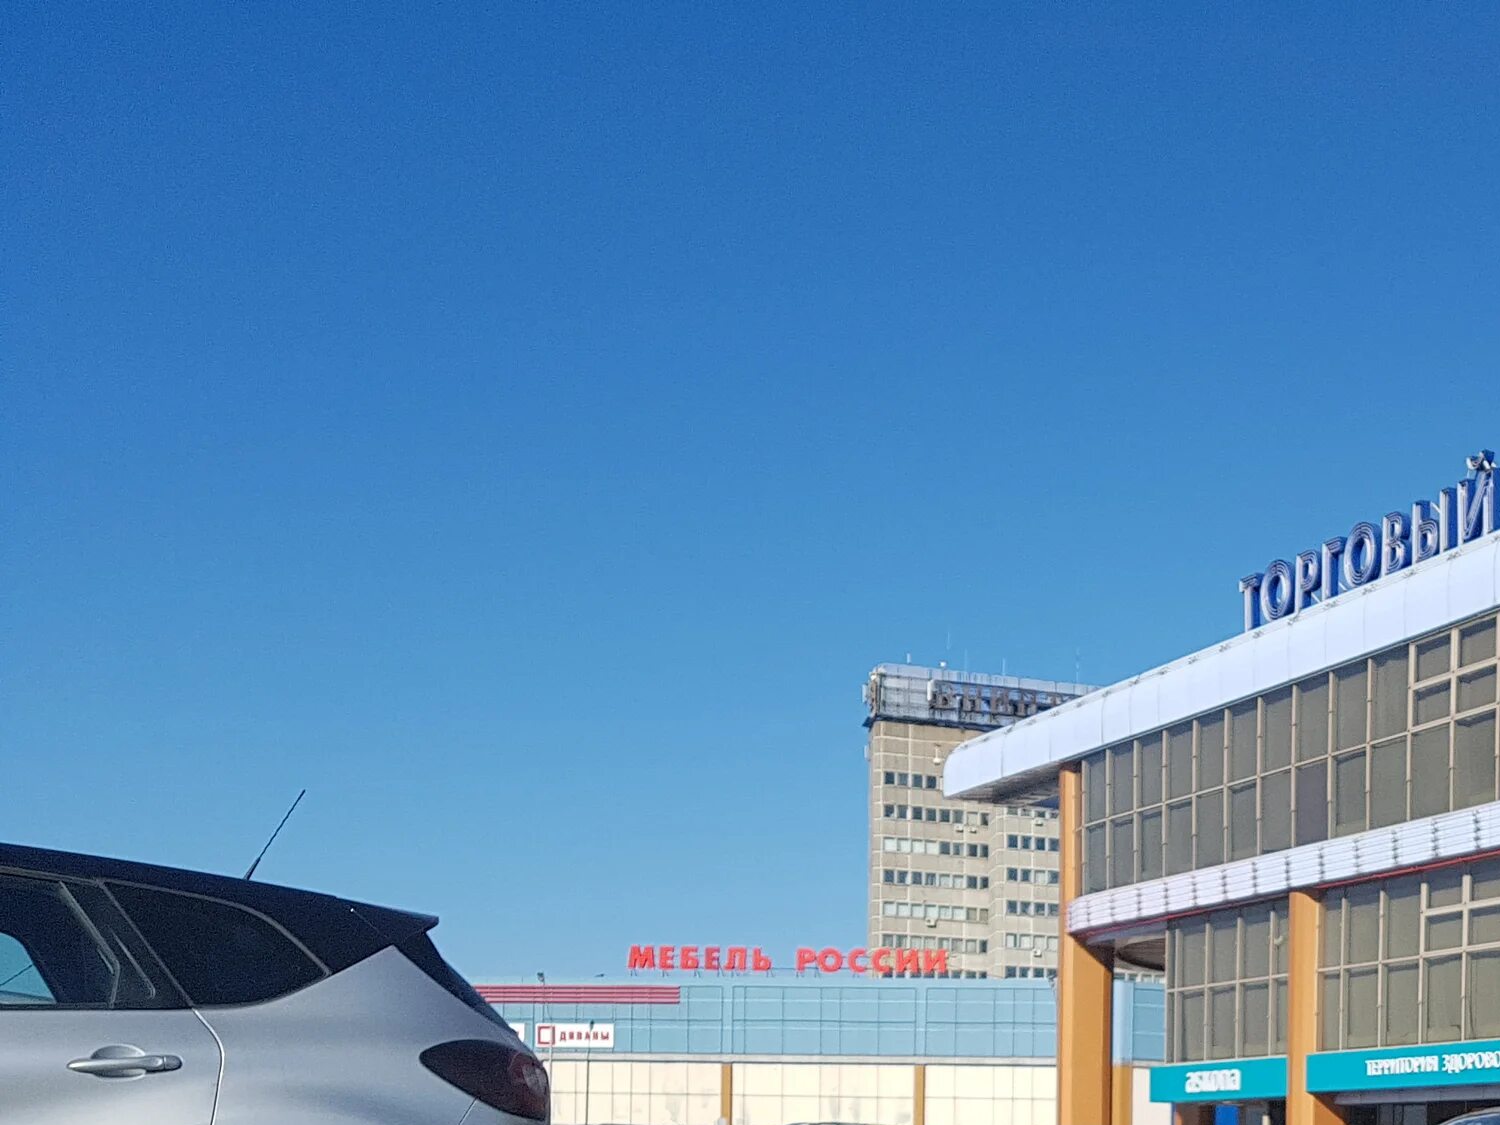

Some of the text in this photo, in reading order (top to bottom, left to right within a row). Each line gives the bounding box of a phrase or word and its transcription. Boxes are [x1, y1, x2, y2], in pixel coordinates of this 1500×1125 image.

[628, 944, 948, 973] МЕБЕЛЬ РОССИИ
[560, 1031, 610, 1042] ДИВАНЫ
[1365, 1056, 1439, 1076] ТЕРРИТОРИЯ
[1185, 1068, 1241, 1093] askona
